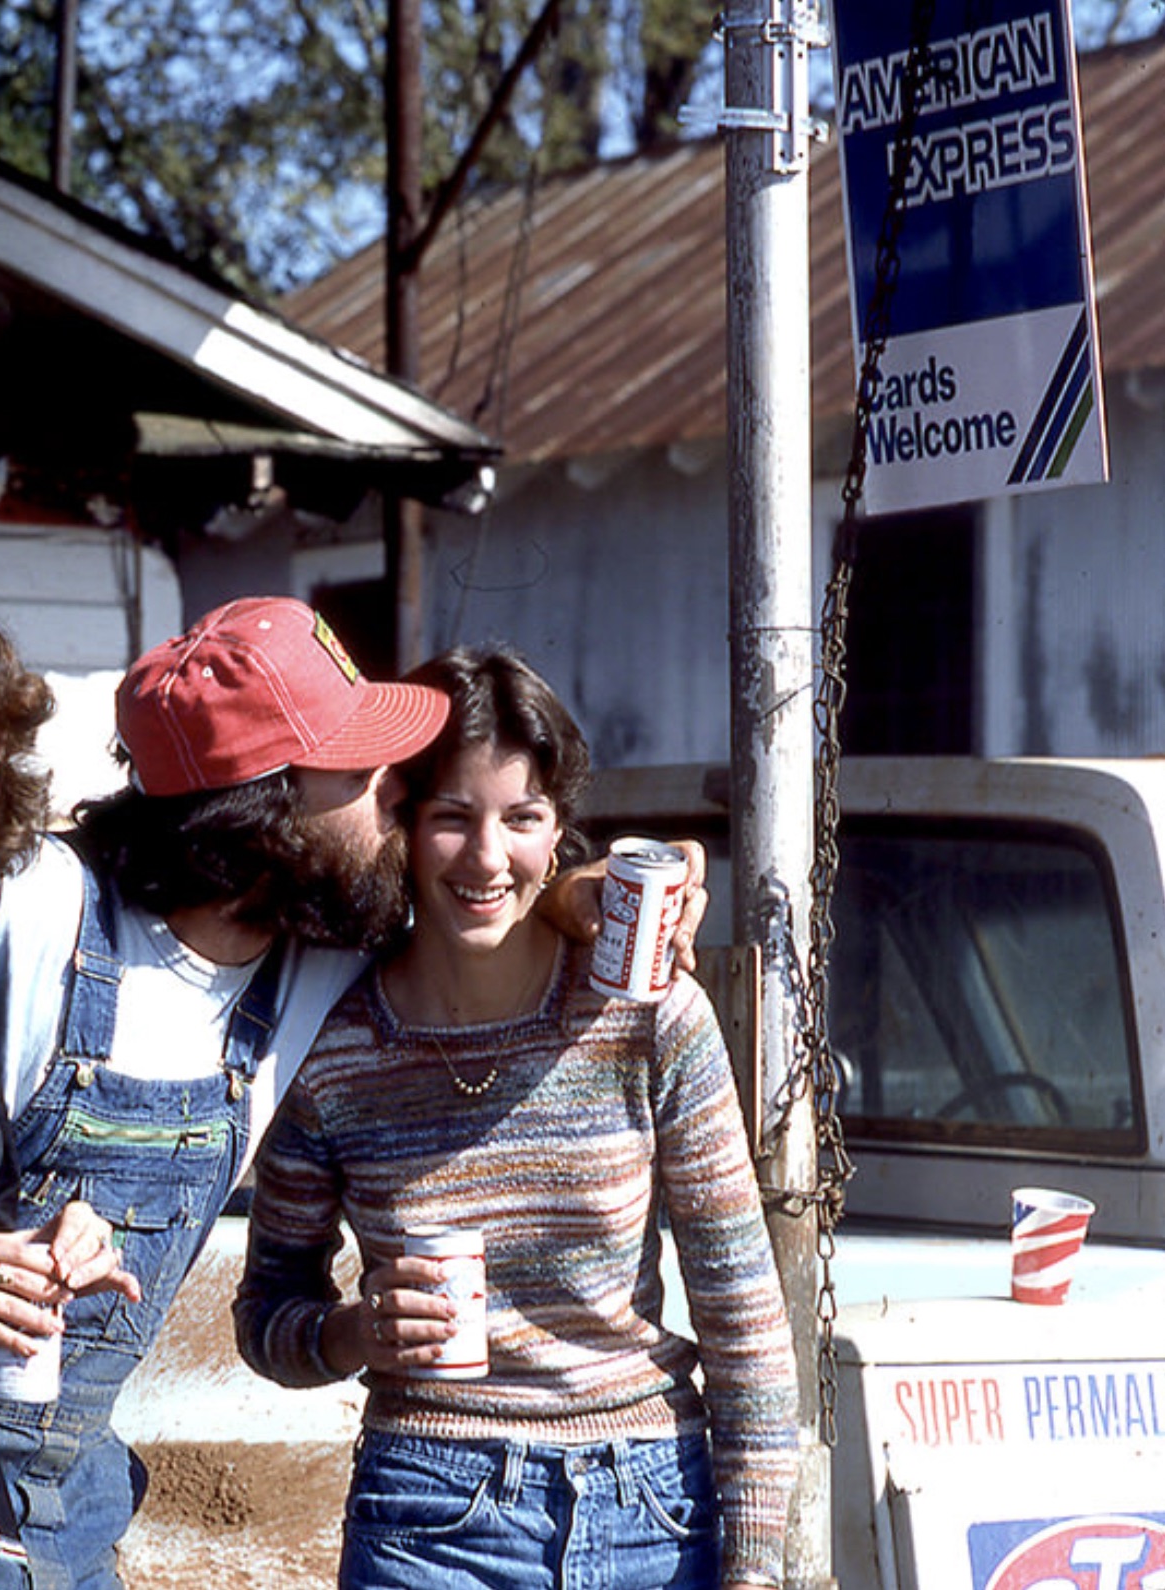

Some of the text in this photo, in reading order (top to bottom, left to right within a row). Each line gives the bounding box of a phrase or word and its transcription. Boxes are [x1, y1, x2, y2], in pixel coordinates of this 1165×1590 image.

[866, 410, 1017, 466] Welcome
[895, 1372, 1165, 1448] SUPER PERMAL
